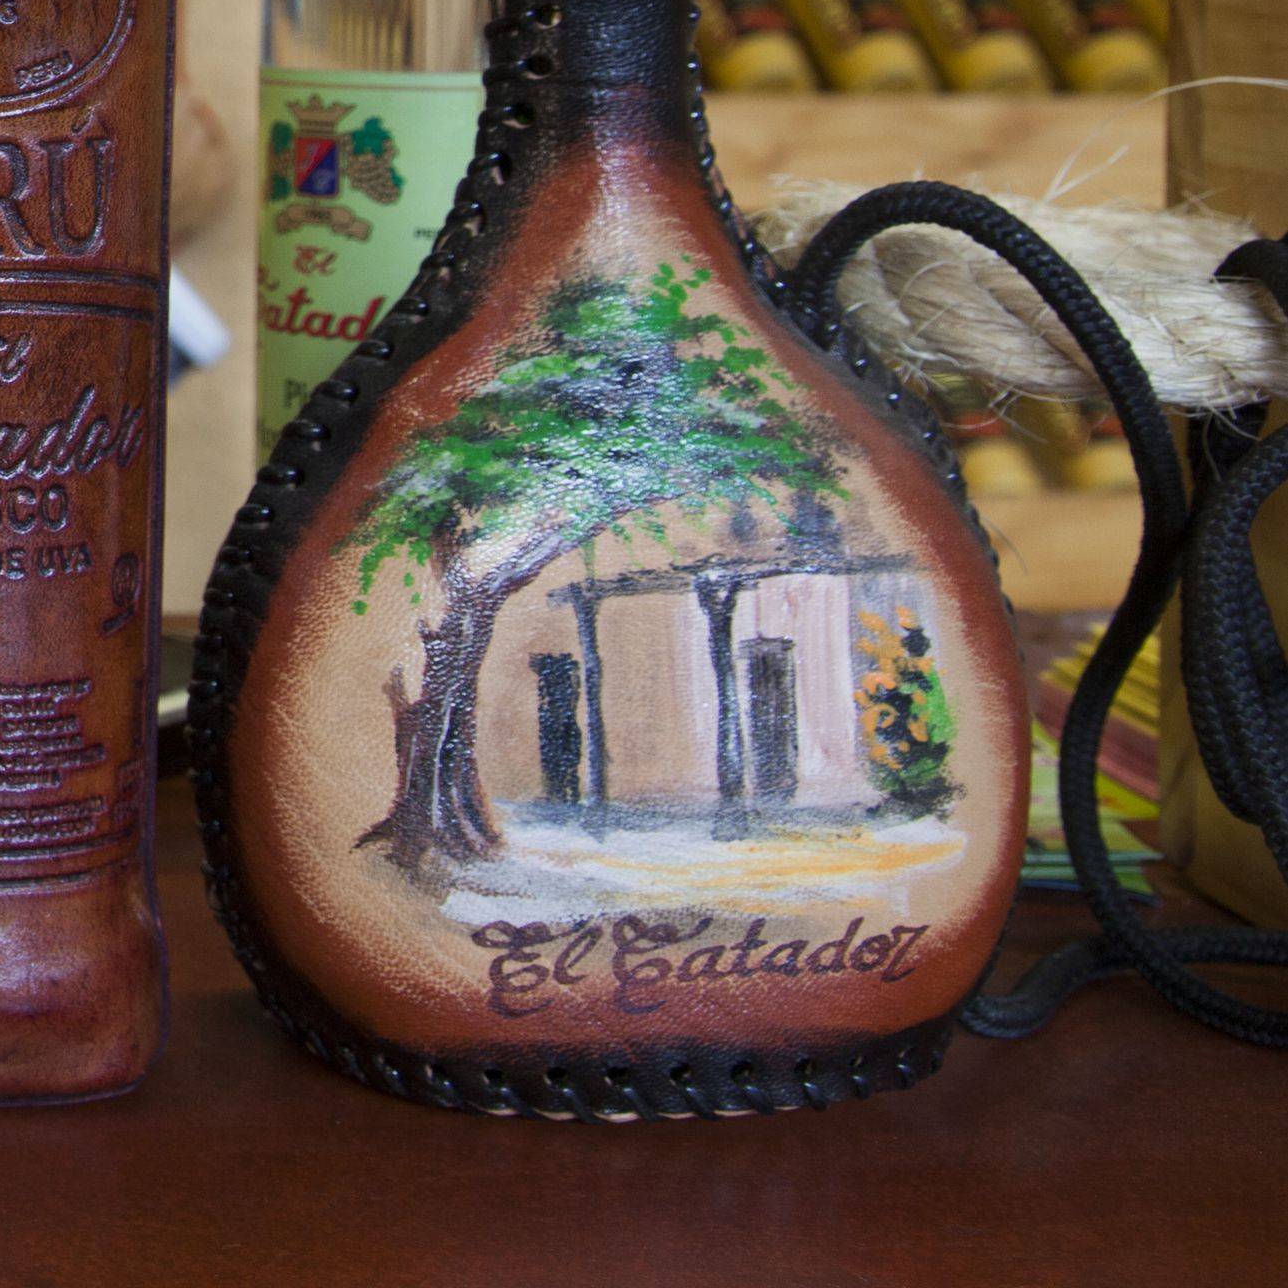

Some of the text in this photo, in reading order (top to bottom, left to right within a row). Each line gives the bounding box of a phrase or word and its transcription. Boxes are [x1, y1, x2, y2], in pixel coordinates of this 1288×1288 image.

[35, 541, 95, 579] UVA
[471, 912, 930, 1018] El Catador
